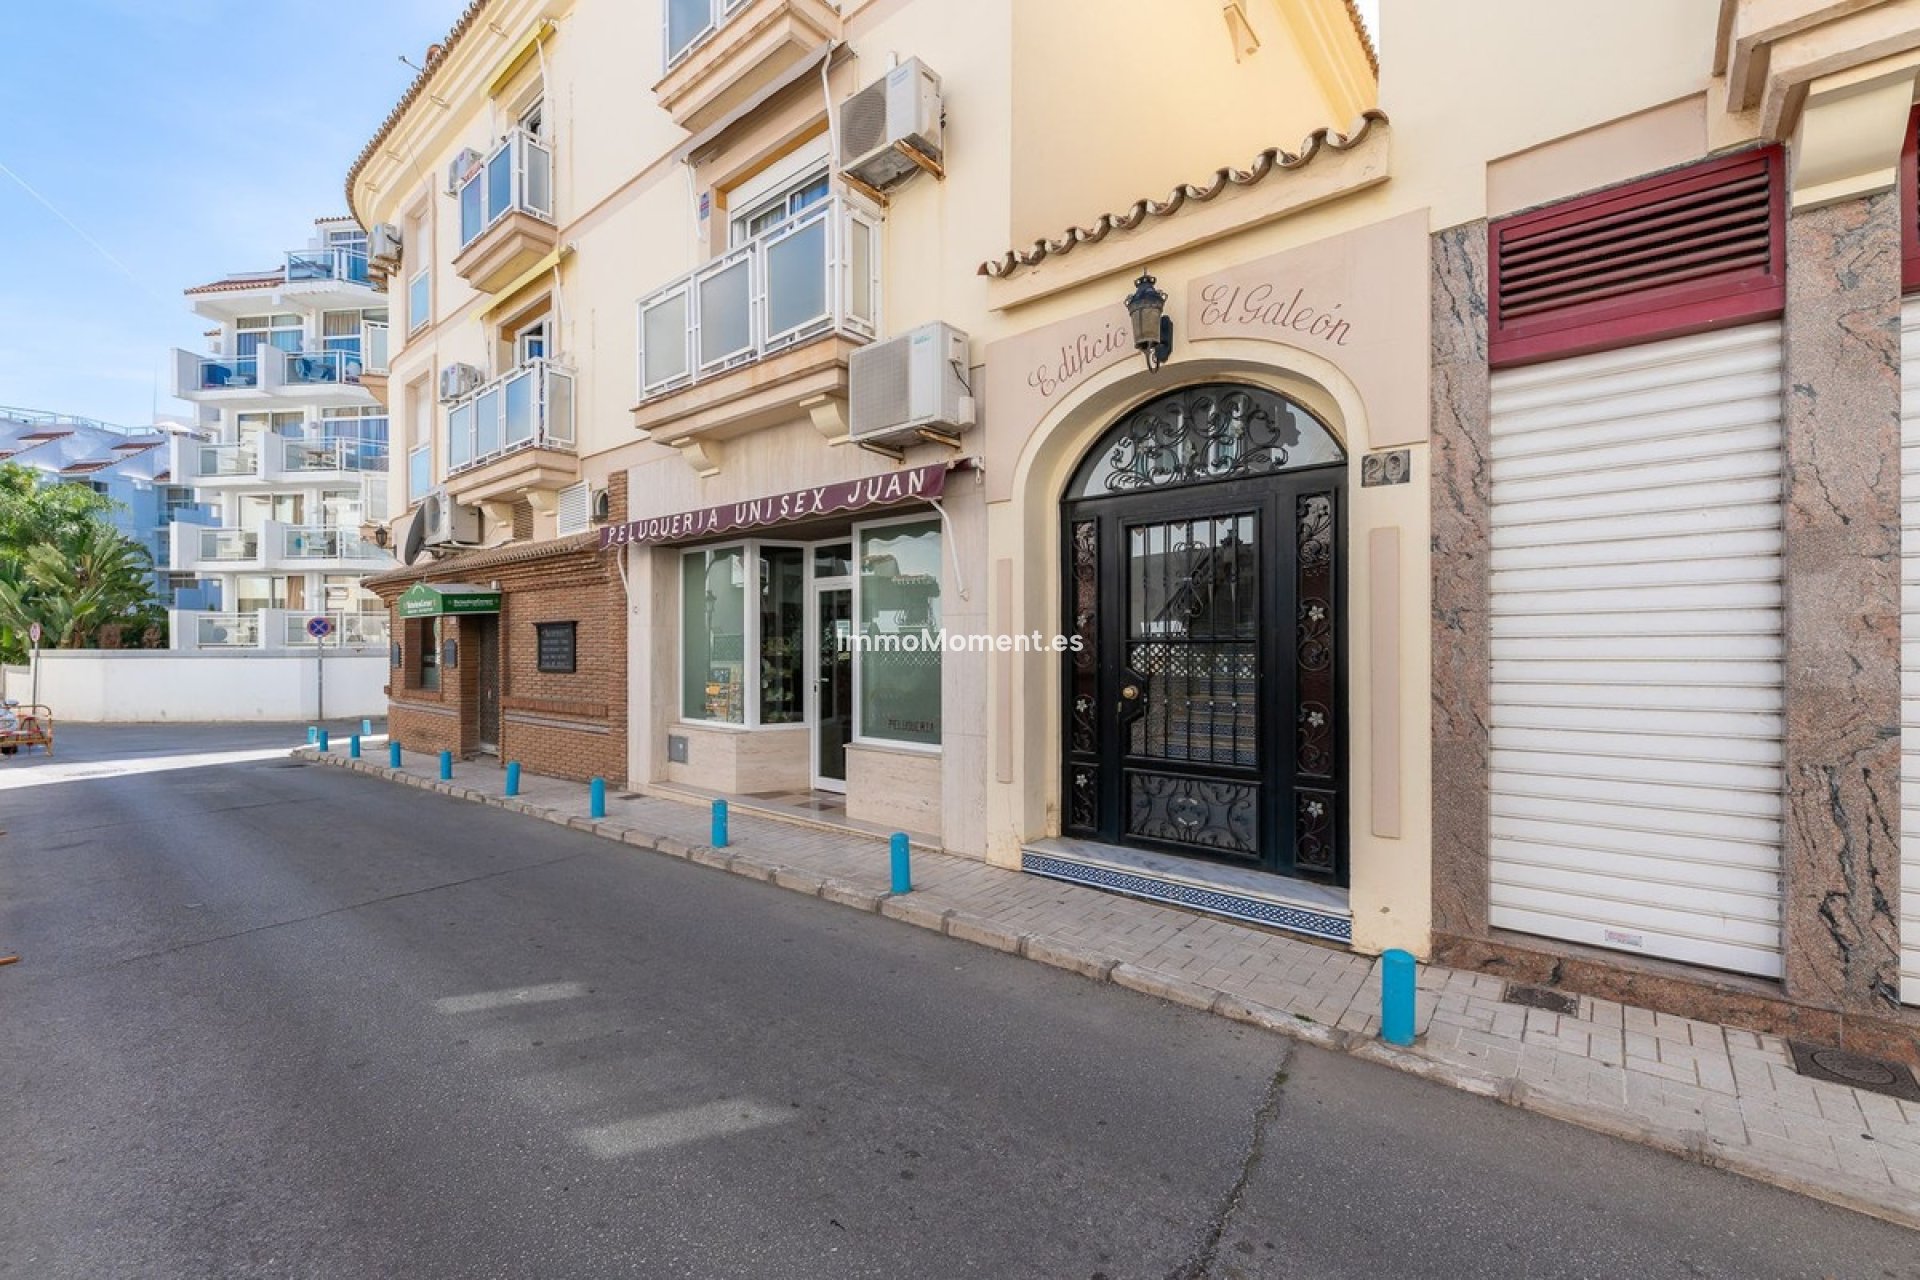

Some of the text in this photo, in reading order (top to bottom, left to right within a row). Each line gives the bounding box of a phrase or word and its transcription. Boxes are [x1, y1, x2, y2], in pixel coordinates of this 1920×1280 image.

[1027, 283, 1351, 397] Edificio El Galeón
[607, 468, 925, 543] PELUQUERIA UNISEX JUAN
